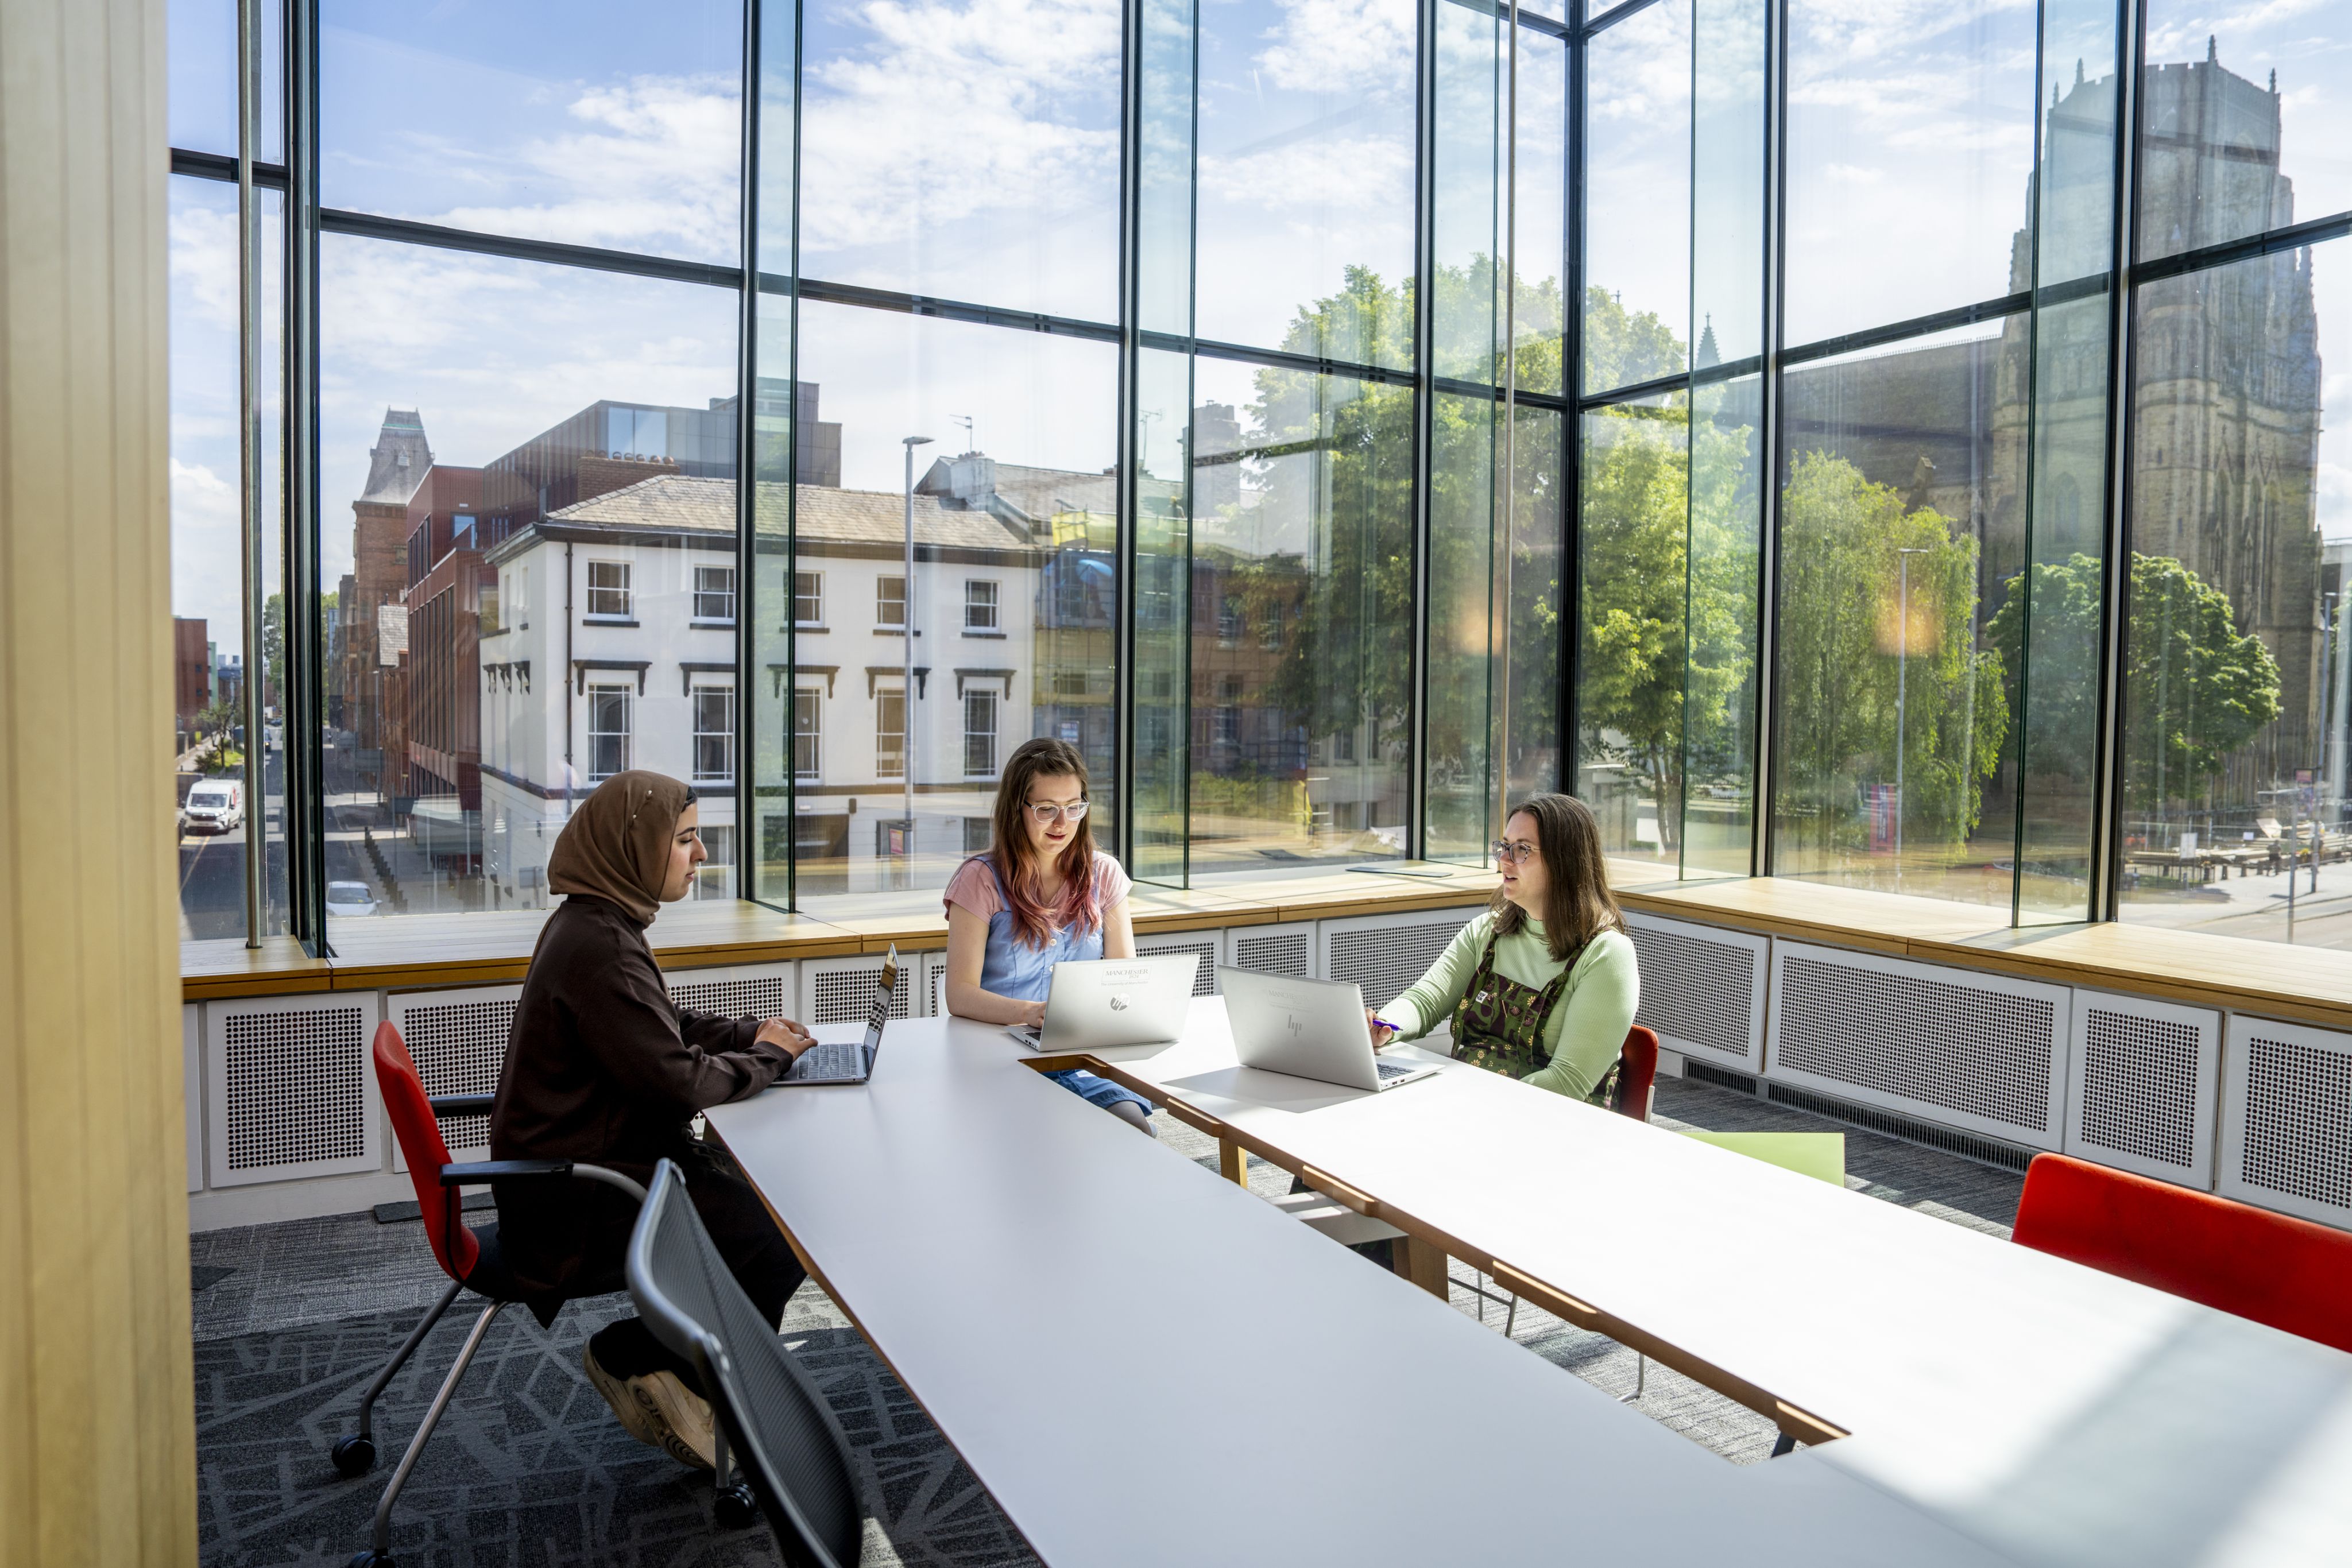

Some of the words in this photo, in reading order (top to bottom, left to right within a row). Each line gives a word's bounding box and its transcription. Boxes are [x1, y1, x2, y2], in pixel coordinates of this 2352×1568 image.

[1111, 993, 1130, 1011] hp
[1268, 989, 1310, 1001] MANCHESTER
[1288, 1015, 1302, 1037] hp
